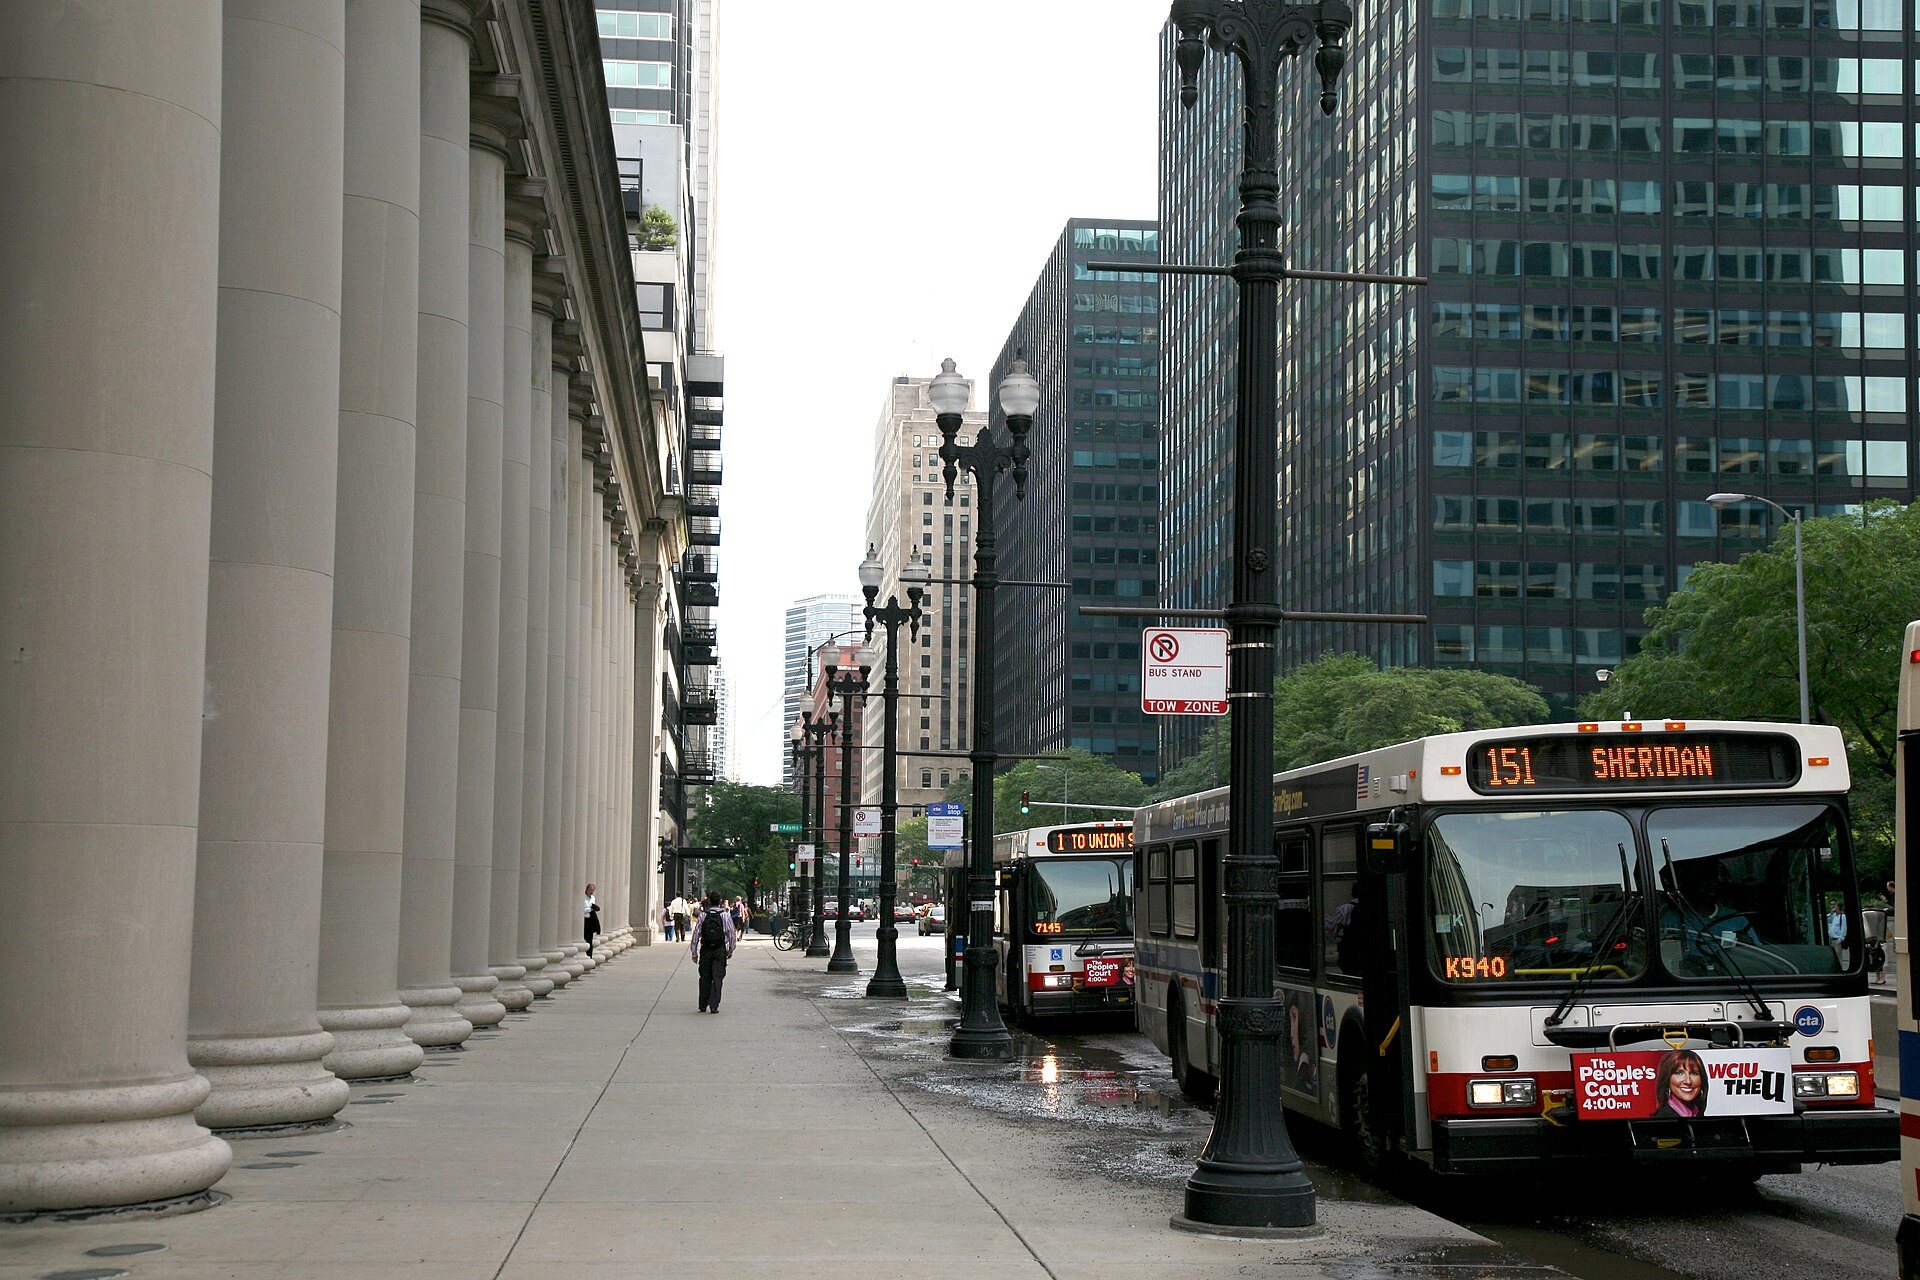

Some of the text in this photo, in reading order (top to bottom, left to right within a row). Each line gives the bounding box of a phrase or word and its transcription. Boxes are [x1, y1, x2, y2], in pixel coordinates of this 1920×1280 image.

[1149, 669, 1202, 678] BUS STAND
[1148, 700, 1220, 713] TOW ZONE
[1487, 745, 1713, 786] 151 SHERIDAN
[1057, 833, 1065, 851] 1
[1071, 833, 1086, 849] TO
[1088, 832, 1125, 849] UNION
[1035, 923, 1061, 933] 7145
[1086, 962, 1119, 971] People's
[1446, 956, 1505, 978] K940
[1798, 1015, 1819, 1027] cta
[1590, 1058, 1616, 1069] The
[1707, 1062, 1759, 1079] WCIU
[1579, 1065, 1657, 1083] People's
[1585, 1081, 1640, 1097] Court
[1723, 1078, 1762, 1095] THE
